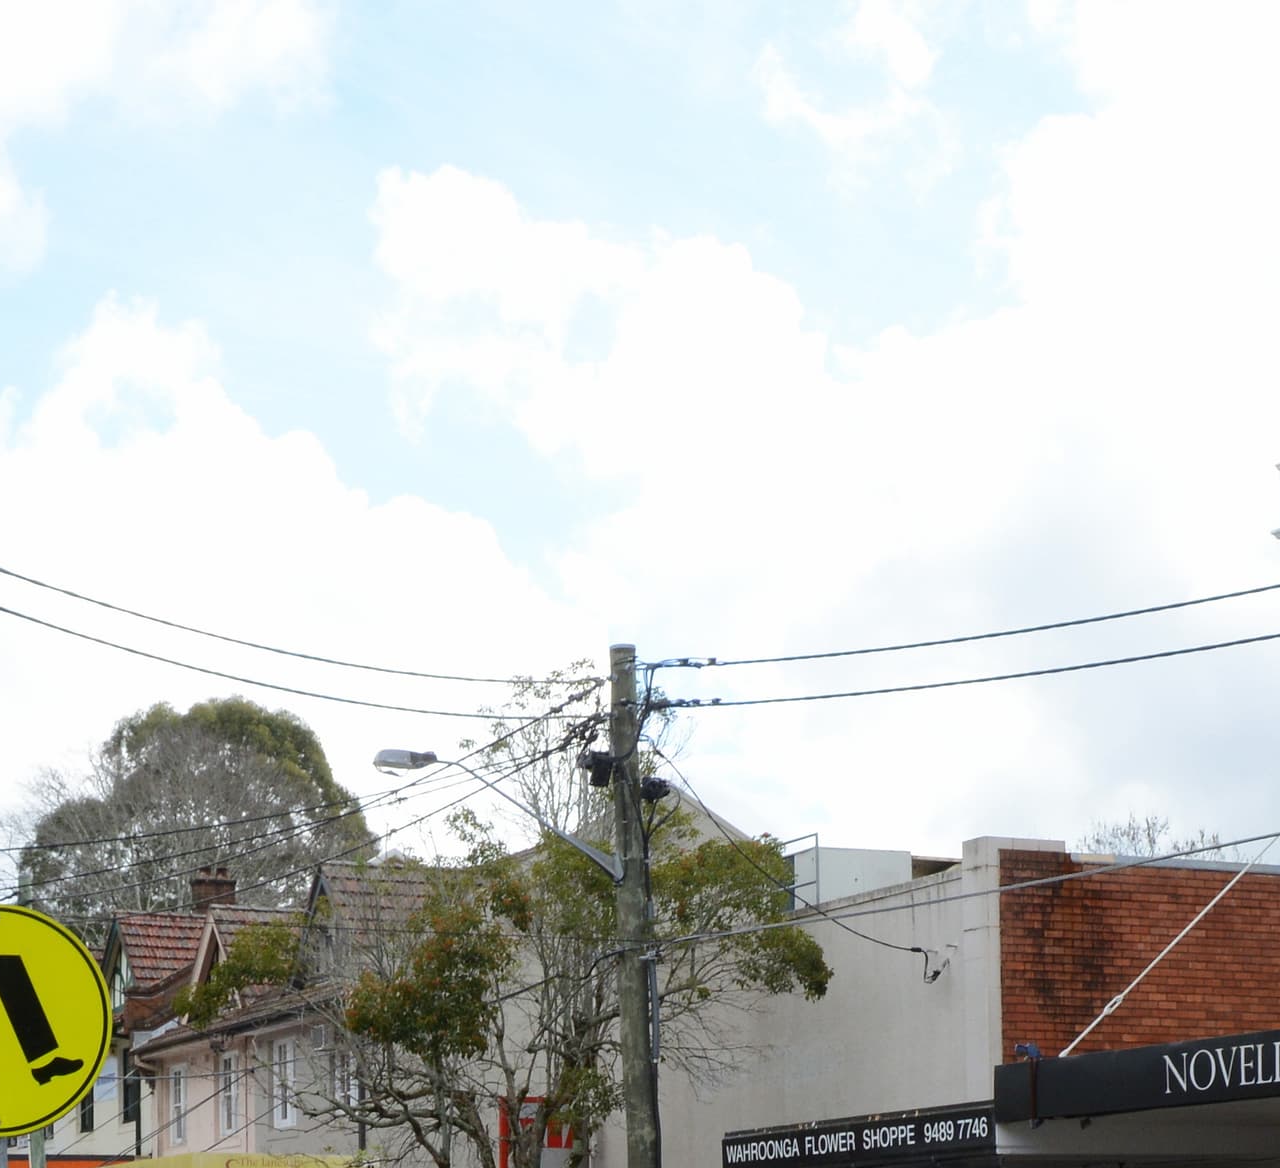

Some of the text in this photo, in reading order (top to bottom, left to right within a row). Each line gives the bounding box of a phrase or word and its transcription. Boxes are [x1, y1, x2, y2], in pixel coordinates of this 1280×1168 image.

[726, 1116, 989, 1164] WAHROONGA FLOWER SHOPPE 9489 7746
